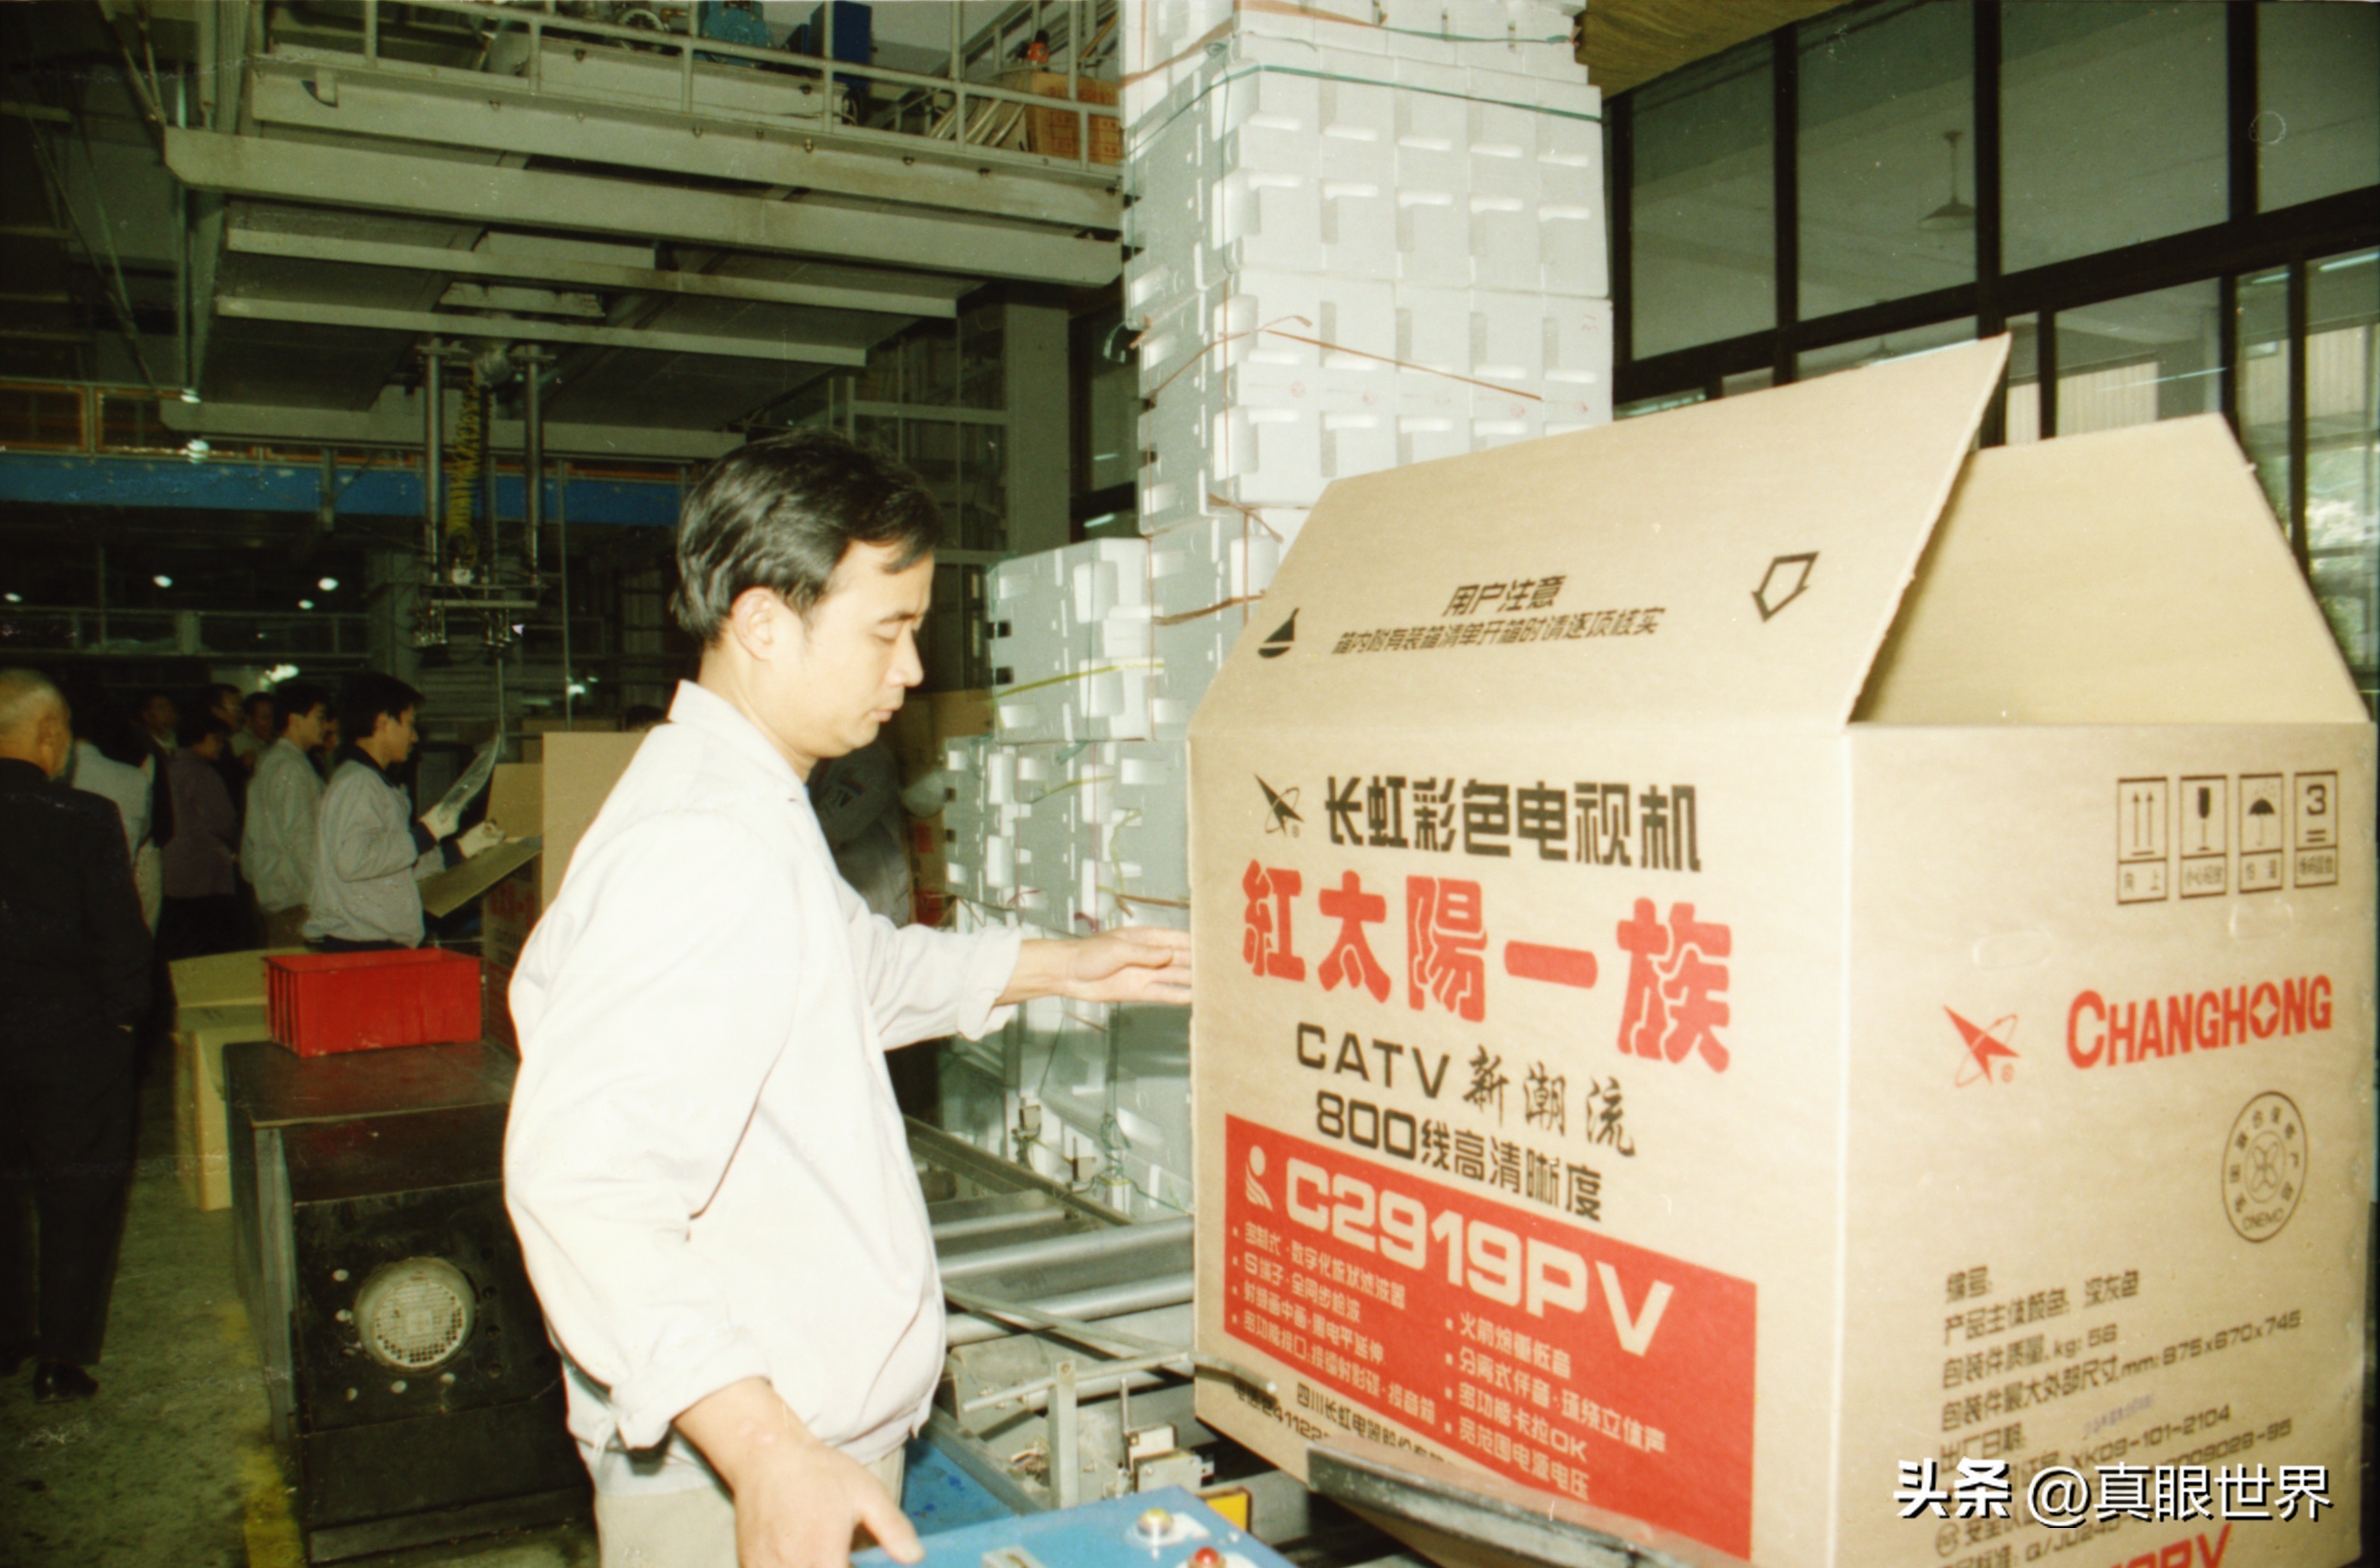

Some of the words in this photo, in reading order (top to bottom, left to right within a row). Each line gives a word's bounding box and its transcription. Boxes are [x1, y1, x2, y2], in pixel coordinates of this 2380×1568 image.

[1443, 575, 1566, 616] 用户注意
[1325, 776, 1702, 872] 长虹彩色电视机
[2307, 783, 2326, 816] 3
[1242, 859, 1732, 1073] 紅太陽一族
[2067, 974, 2333, 1070] CHANGHONG
[1297, 1022, 1450, 1099] CATV
[1464, 1045, 1635, 1157] 新潮流
[1317, 1089, 1601, 1222] 800线高清晰度
[1286, 1157, 1675, 1357] C2919PV
[2085, 1269, 2138, 1308] 深灰色
[1459, 1312, 1570, 1379] 火箭炮重低音
[1459, 1416, 1589, 1501] 宽范围电源电压
